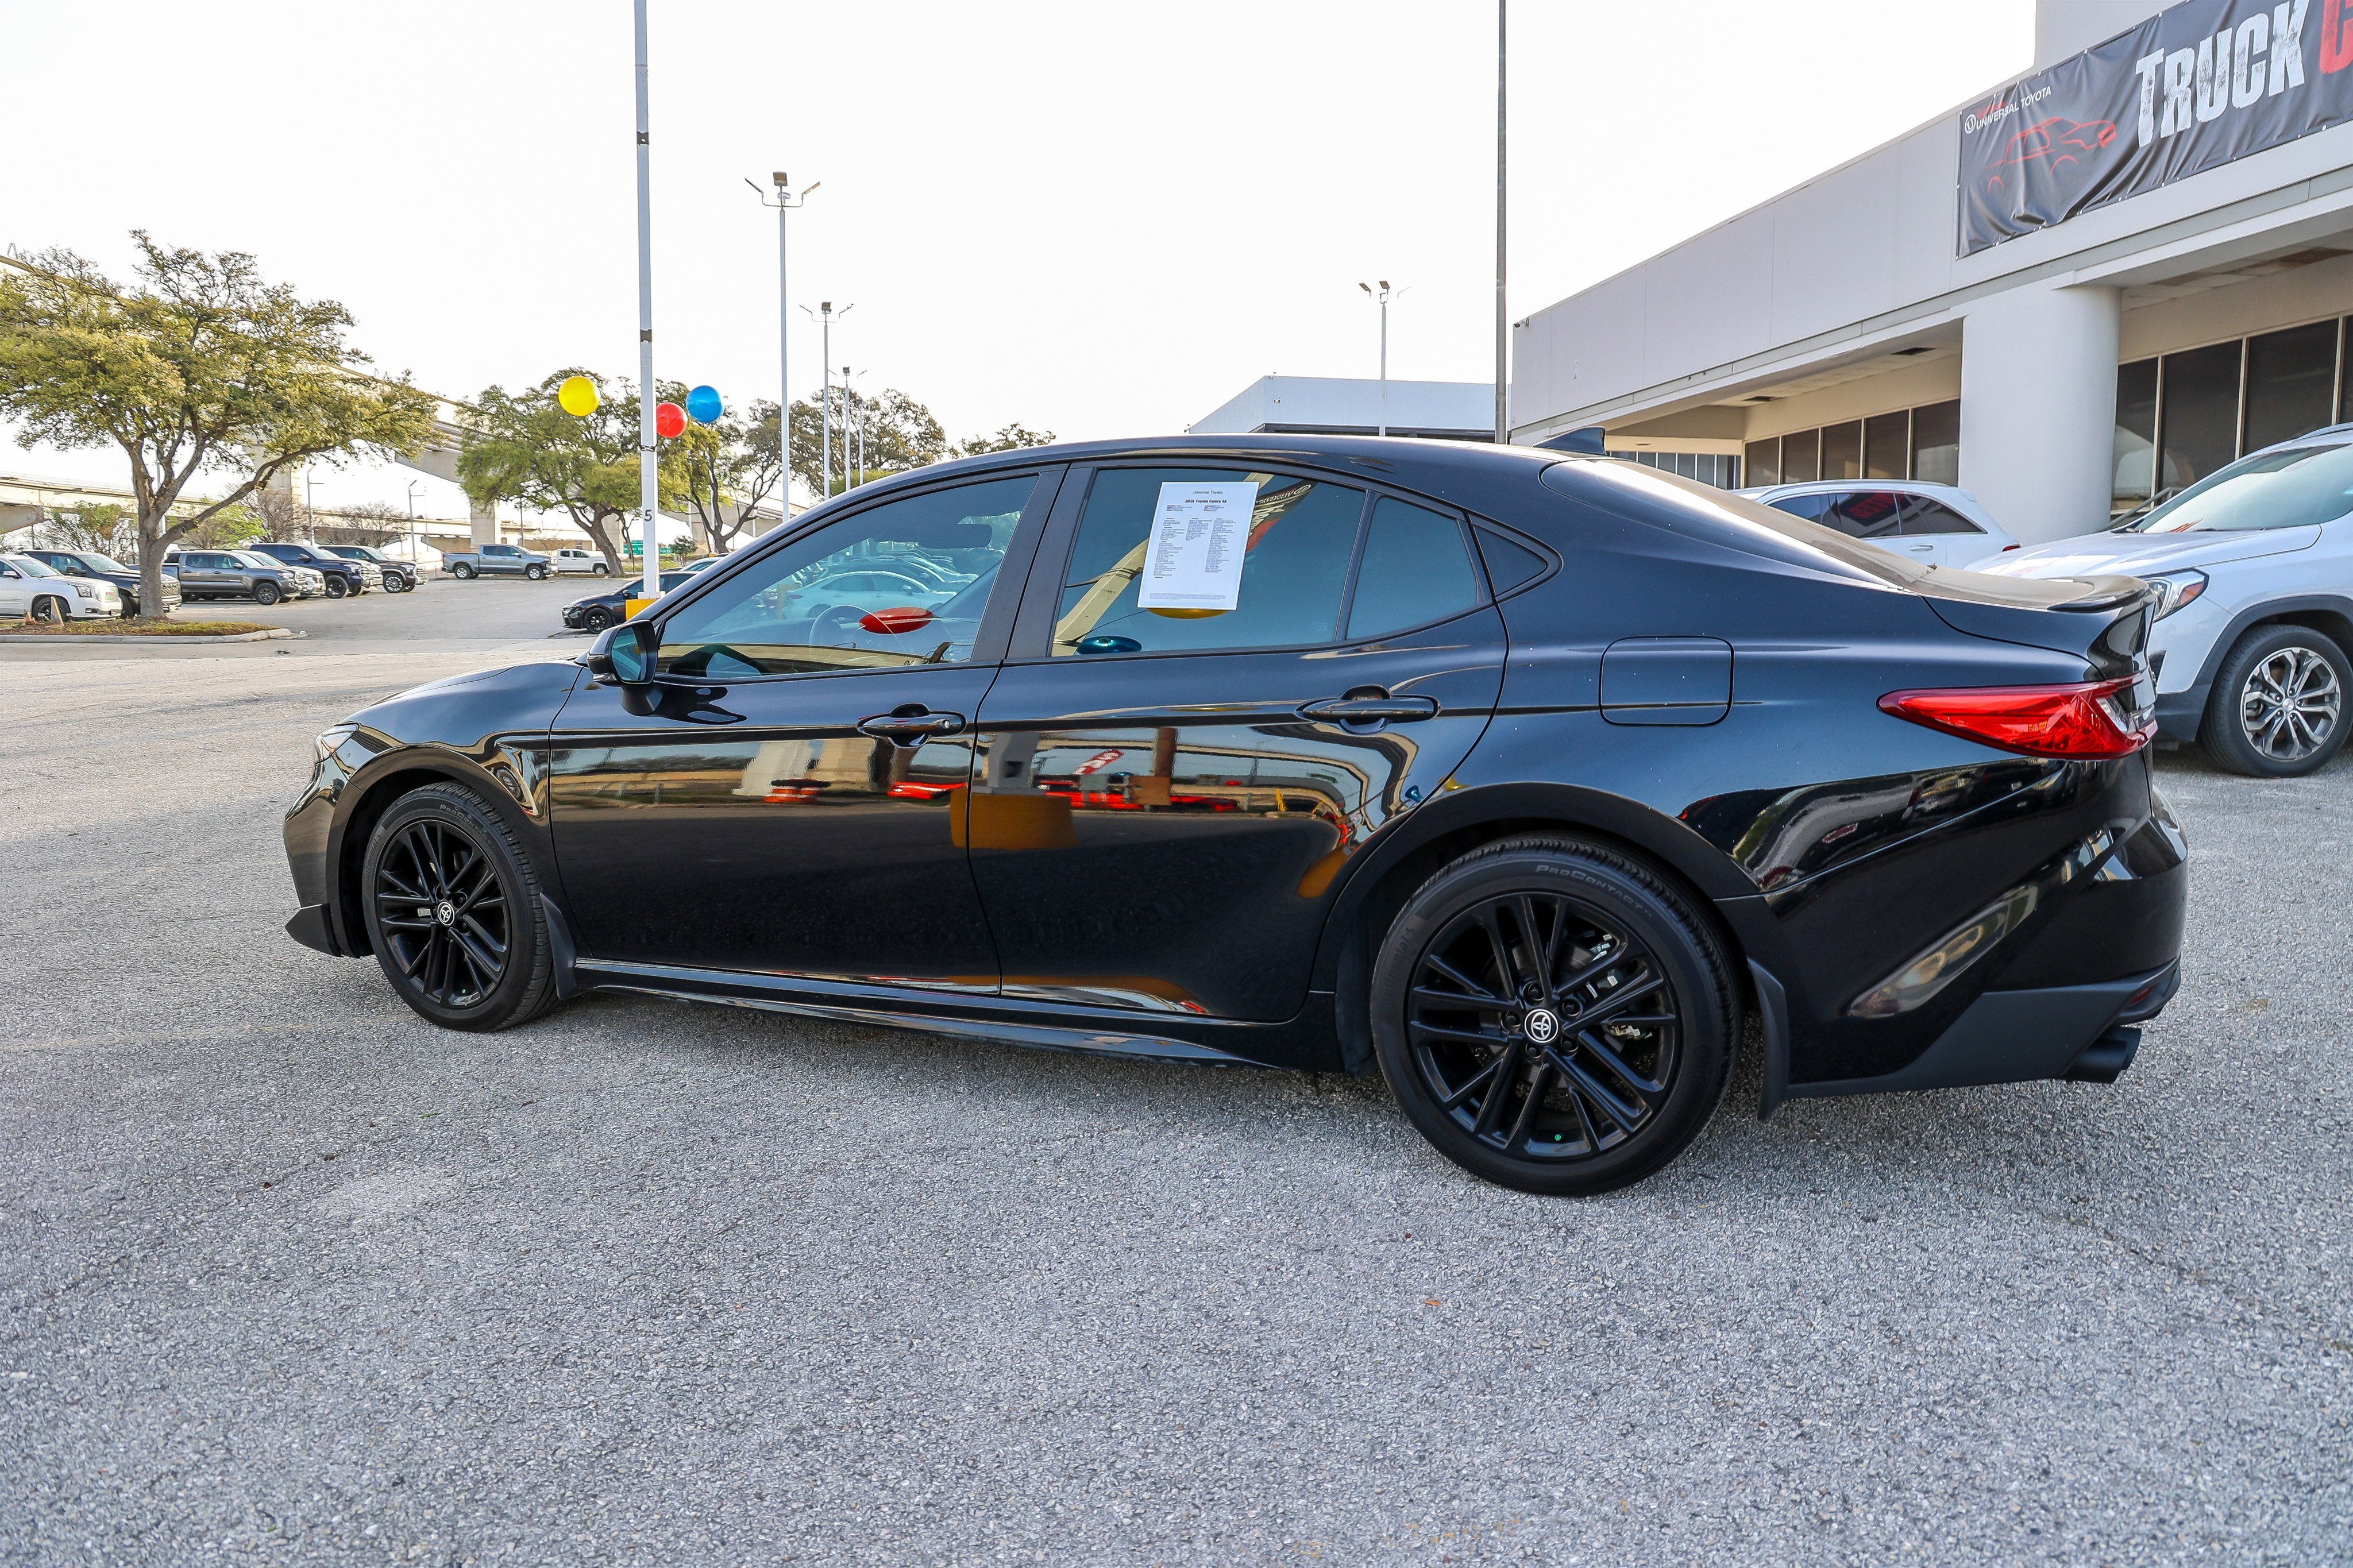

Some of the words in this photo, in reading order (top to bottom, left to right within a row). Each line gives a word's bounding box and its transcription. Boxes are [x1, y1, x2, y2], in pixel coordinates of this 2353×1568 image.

[2135, 0, 2310, 148] TRUCK
[1976, 101, 2019, 130] UNIVERSAL
[2020, 86, 2051, 109] TOYOTA
[644, 509, 653, 522] 5
